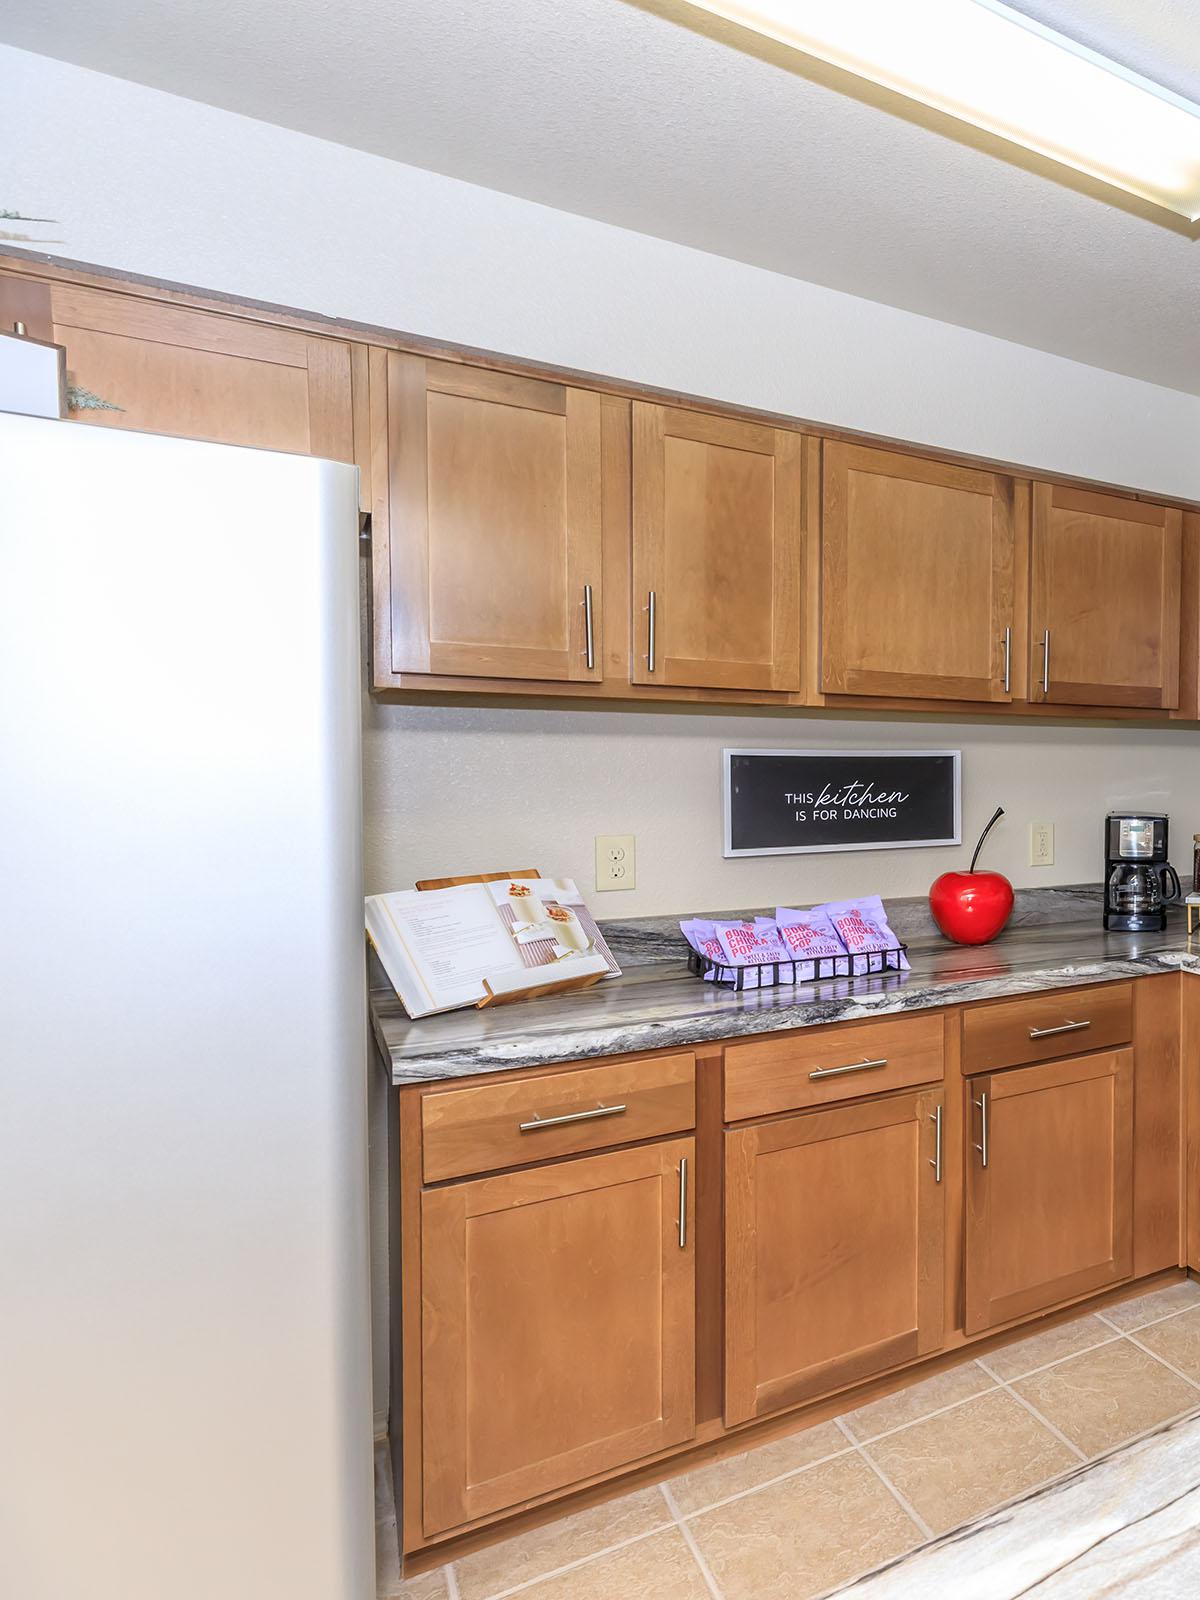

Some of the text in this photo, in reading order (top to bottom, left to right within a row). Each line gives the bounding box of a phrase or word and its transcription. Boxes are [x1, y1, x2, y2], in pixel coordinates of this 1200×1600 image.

[785, 780, 909, 808] THIS kitchen
[795, 808, 897, 821] IS FOR DANCING
[837, 917, 865, 930] BOOM
[725, 928, 757, 940] BOOM
[842, 926, 877, 939] CHICKA
[728, 936, 768, 949] CHICKA
[793, 938, 811, 953] POP
[845, 934, 865, 950] POP
[731, 945, 753, 958] POP
